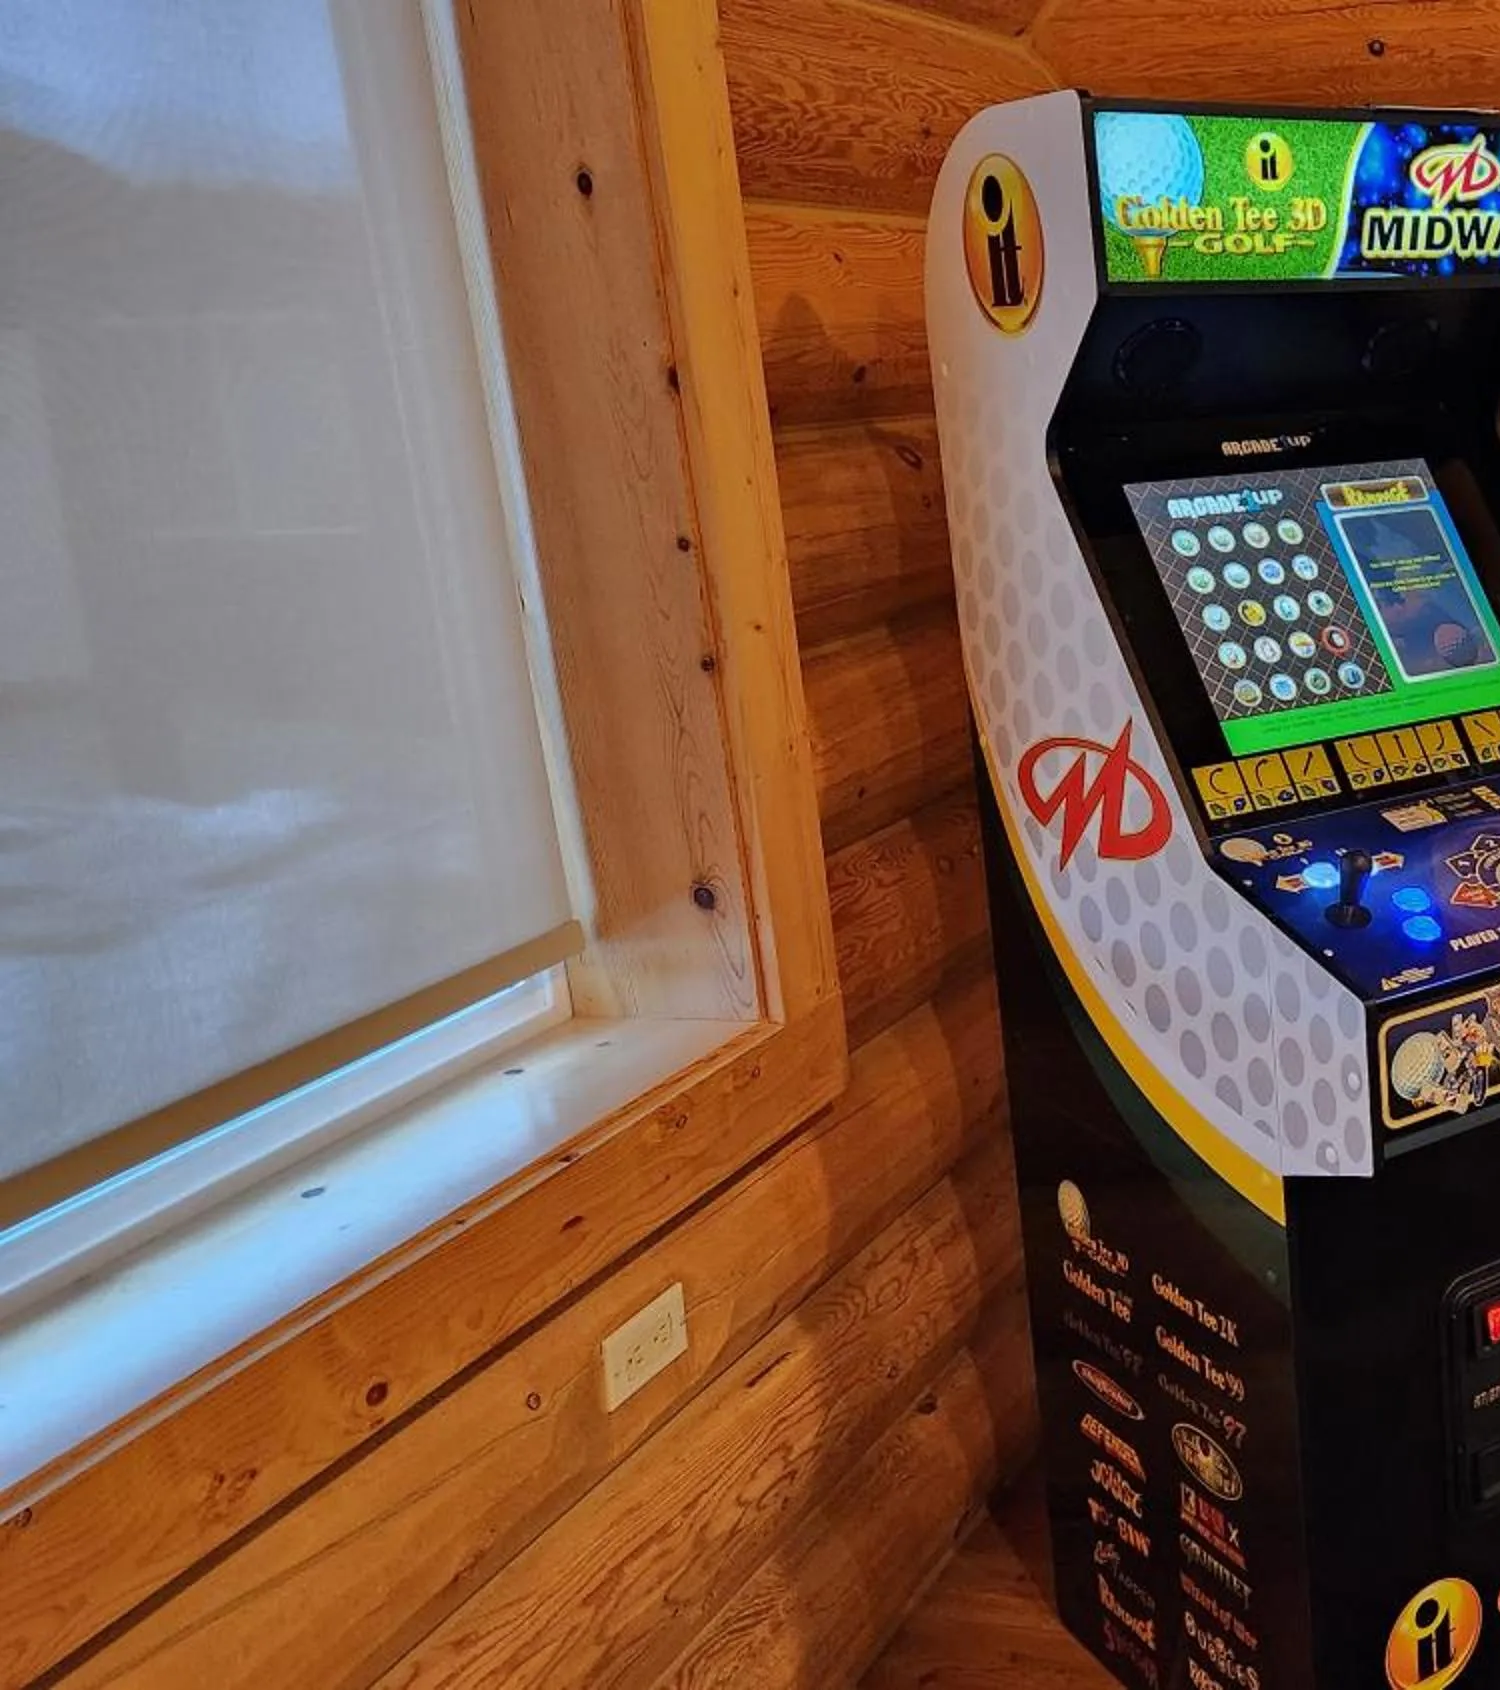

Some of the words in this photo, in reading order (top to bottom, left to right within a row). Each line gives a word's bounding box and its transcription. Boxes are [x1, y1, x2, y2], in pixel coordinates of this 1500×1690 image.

[1116, 195, 1224, 231] Golden
[1229, 196, 1278, 232] Tee
[1288, 196, 1327, 232] 3D
[1192, 232, 1298, 255] GOLF
[1449, 928, 1500, 952] PLAYER
[1063, 1259, 1107, 1307] Golden
[1107, 1287, 1131, 1324] Tee
[1152, 1273, 1195, 1319] Golden
[1195, 1299, 1219, 1332] Tee
[1219, 1315, 1239, 1348] 2K
[1156, 1324, 1200, 1373] Golden
[1201, 1354, 1227, 1392] Tee
